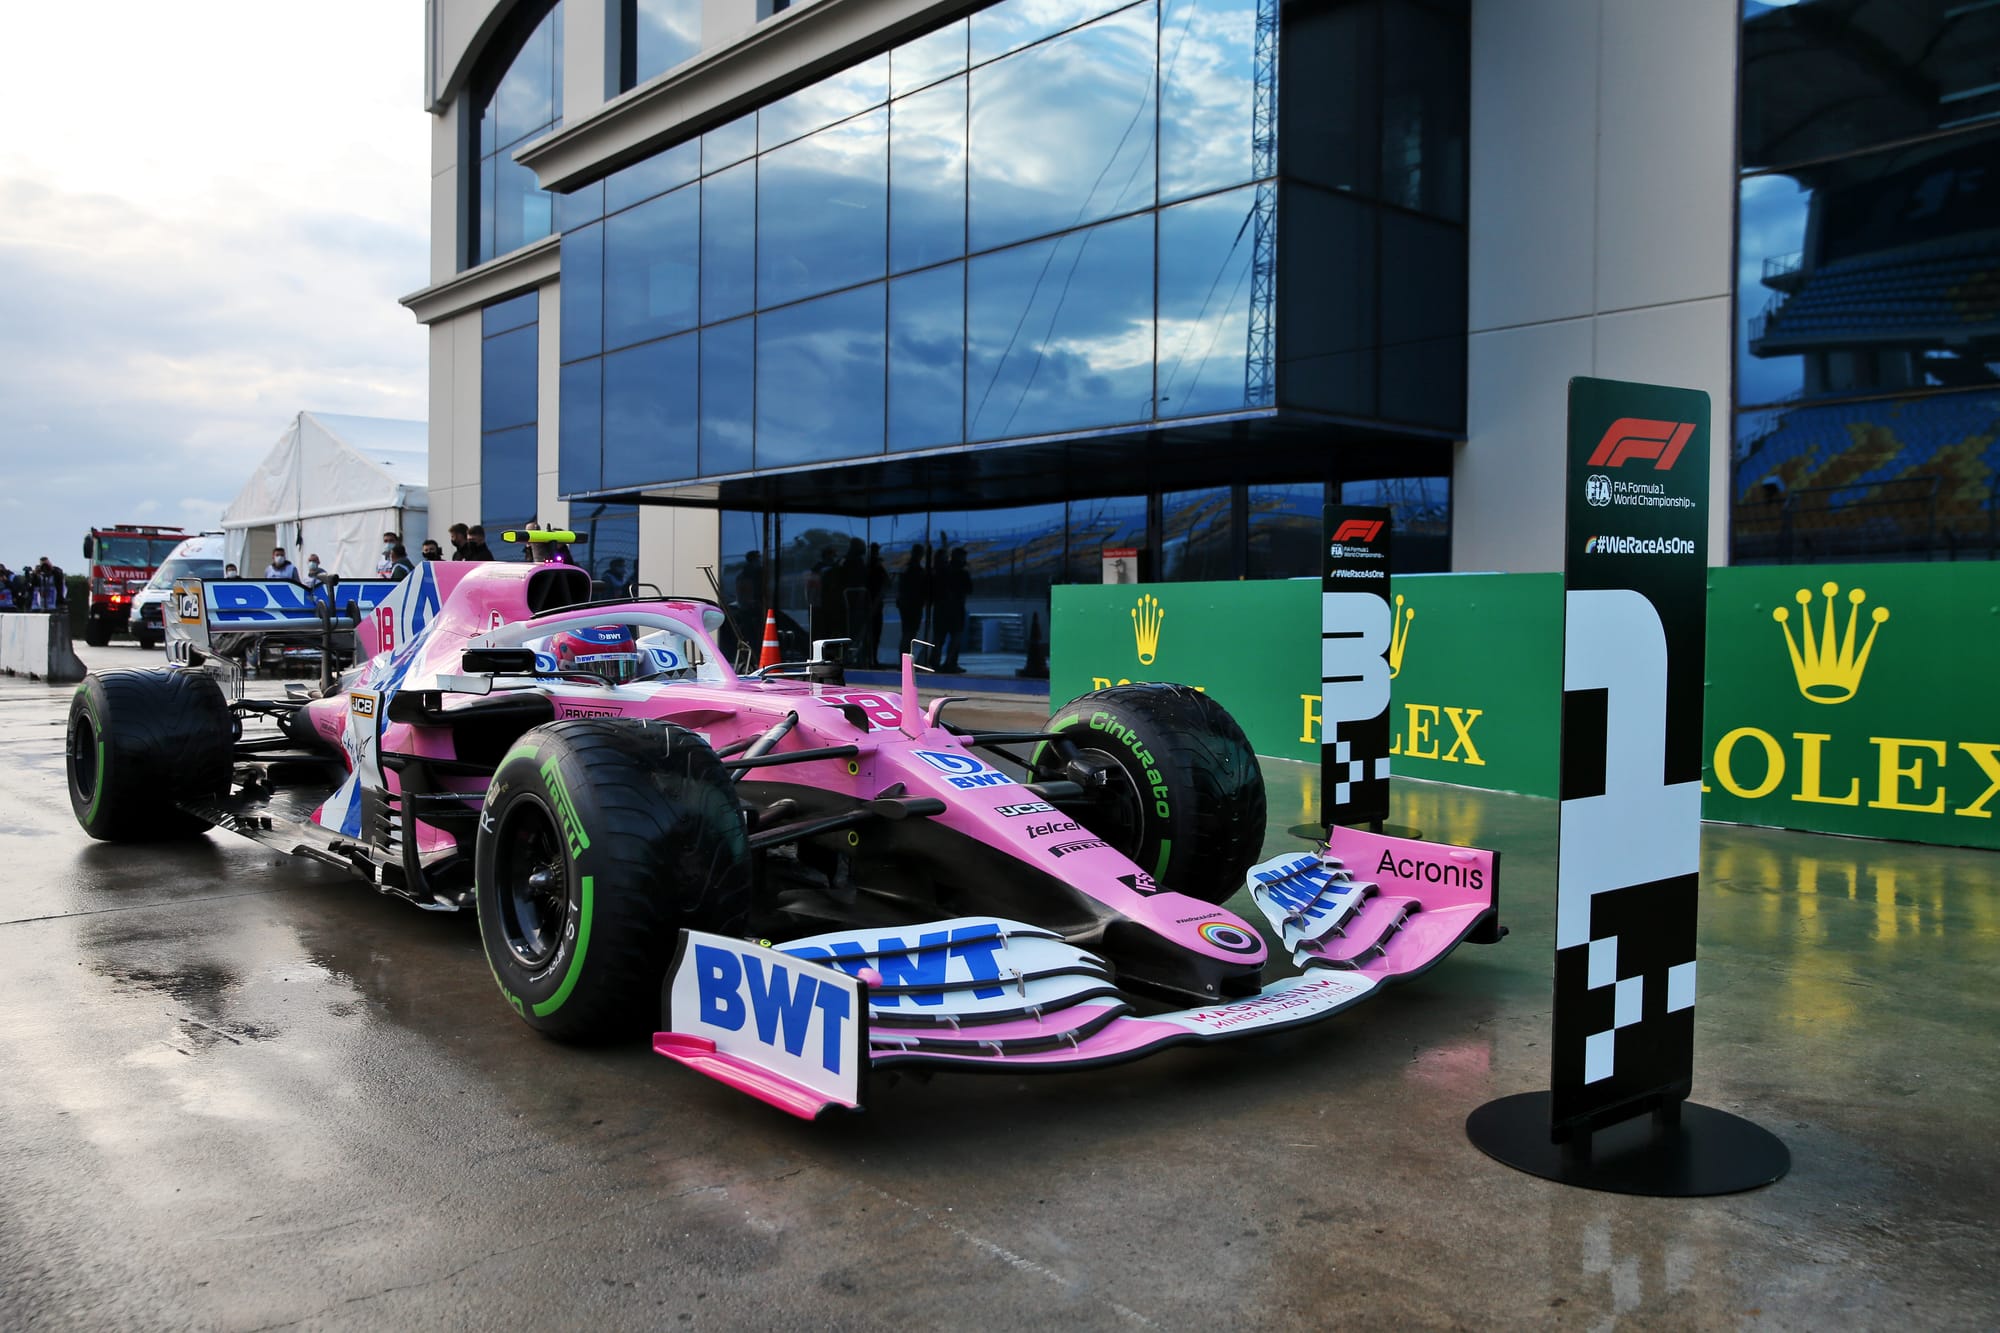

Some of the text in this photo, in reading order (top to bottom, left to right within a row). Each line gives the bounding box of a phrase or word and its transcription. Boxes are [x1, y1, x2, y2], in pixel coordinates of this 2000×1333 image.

[1587, 417, 1697, 471] F1
[1613, 494, 1690, 508] World Championship
[1614, 481, 1665, 495] FIA Formula 1
[1331, 519, 1385, 542] F1
[1597, 535, 1695, 554] #WeRaceAsOne
[376, 607, 395, 653] 18
[1321, 591, 1392, 744] 3
[352, 697, 373, 714] JCB
[953, 772, 1013, 789] BWT
[1089, 711, 1170, 818] Cinturato
[998, 802, 1054, 816] JCB
[1376, 849, 1484, 890] Acronis
[694, 943, 850, 1076] BWT
[1184, 979, 1341, 1023] MAGNESIUM
[1211, 984, 1361, 1030] MINERALIZED WATER
